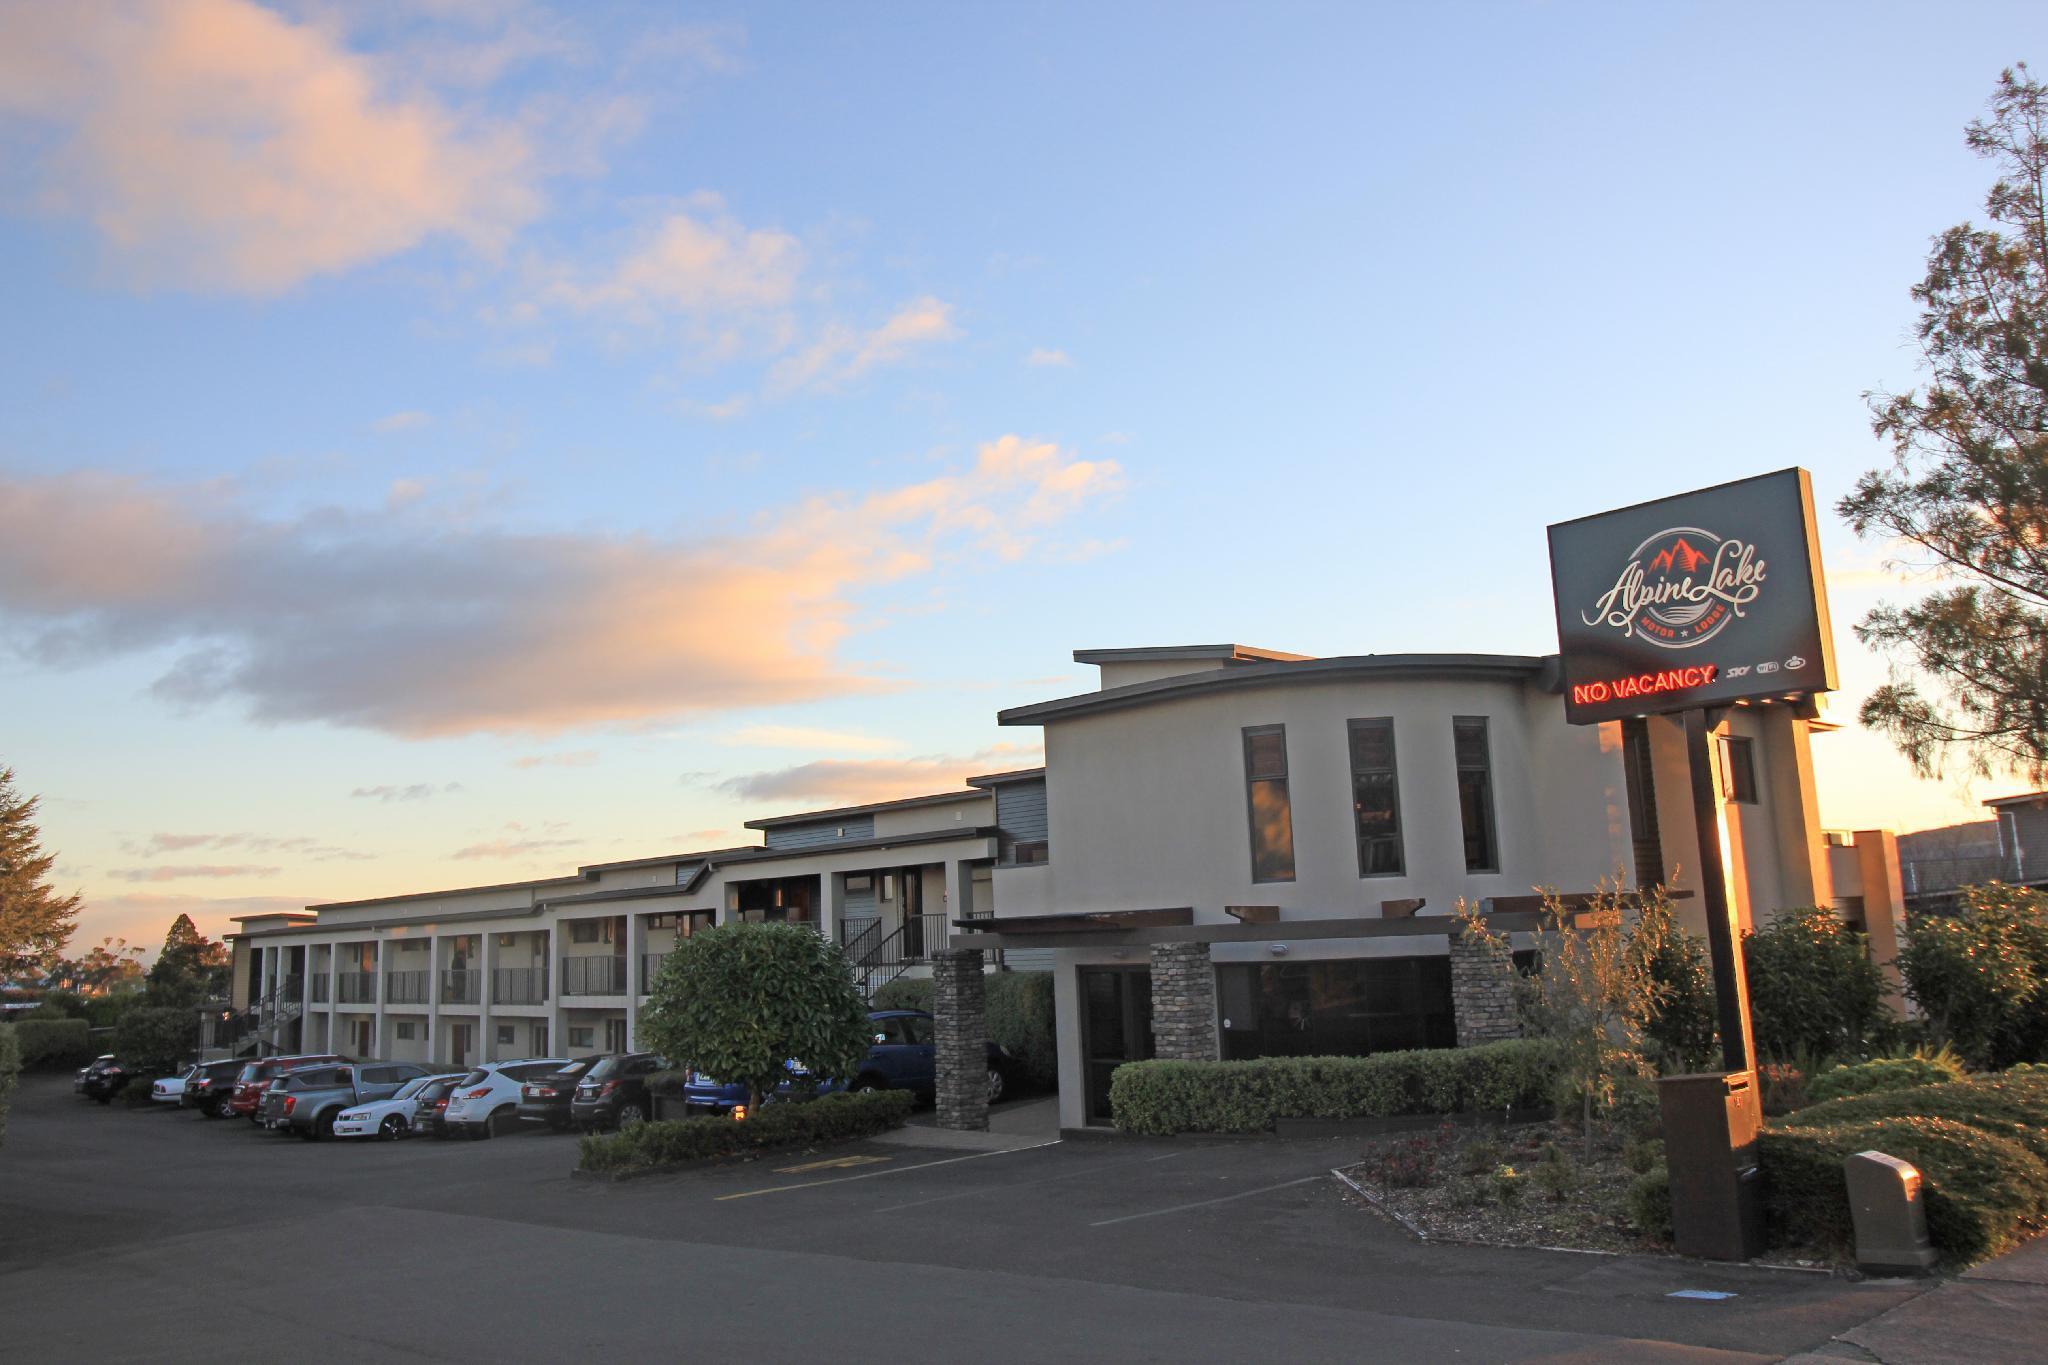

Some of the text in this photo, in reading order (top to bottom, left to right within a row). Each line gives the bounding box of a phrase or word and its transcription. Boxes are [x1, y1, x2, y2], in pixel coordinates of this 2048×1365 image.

[1581, 539, 1767, 638] Alpine Lake
[1640, 603, 1726, 639] MOTOR LODGE
[1573, 664, 1716, 704] NO VACANCY
